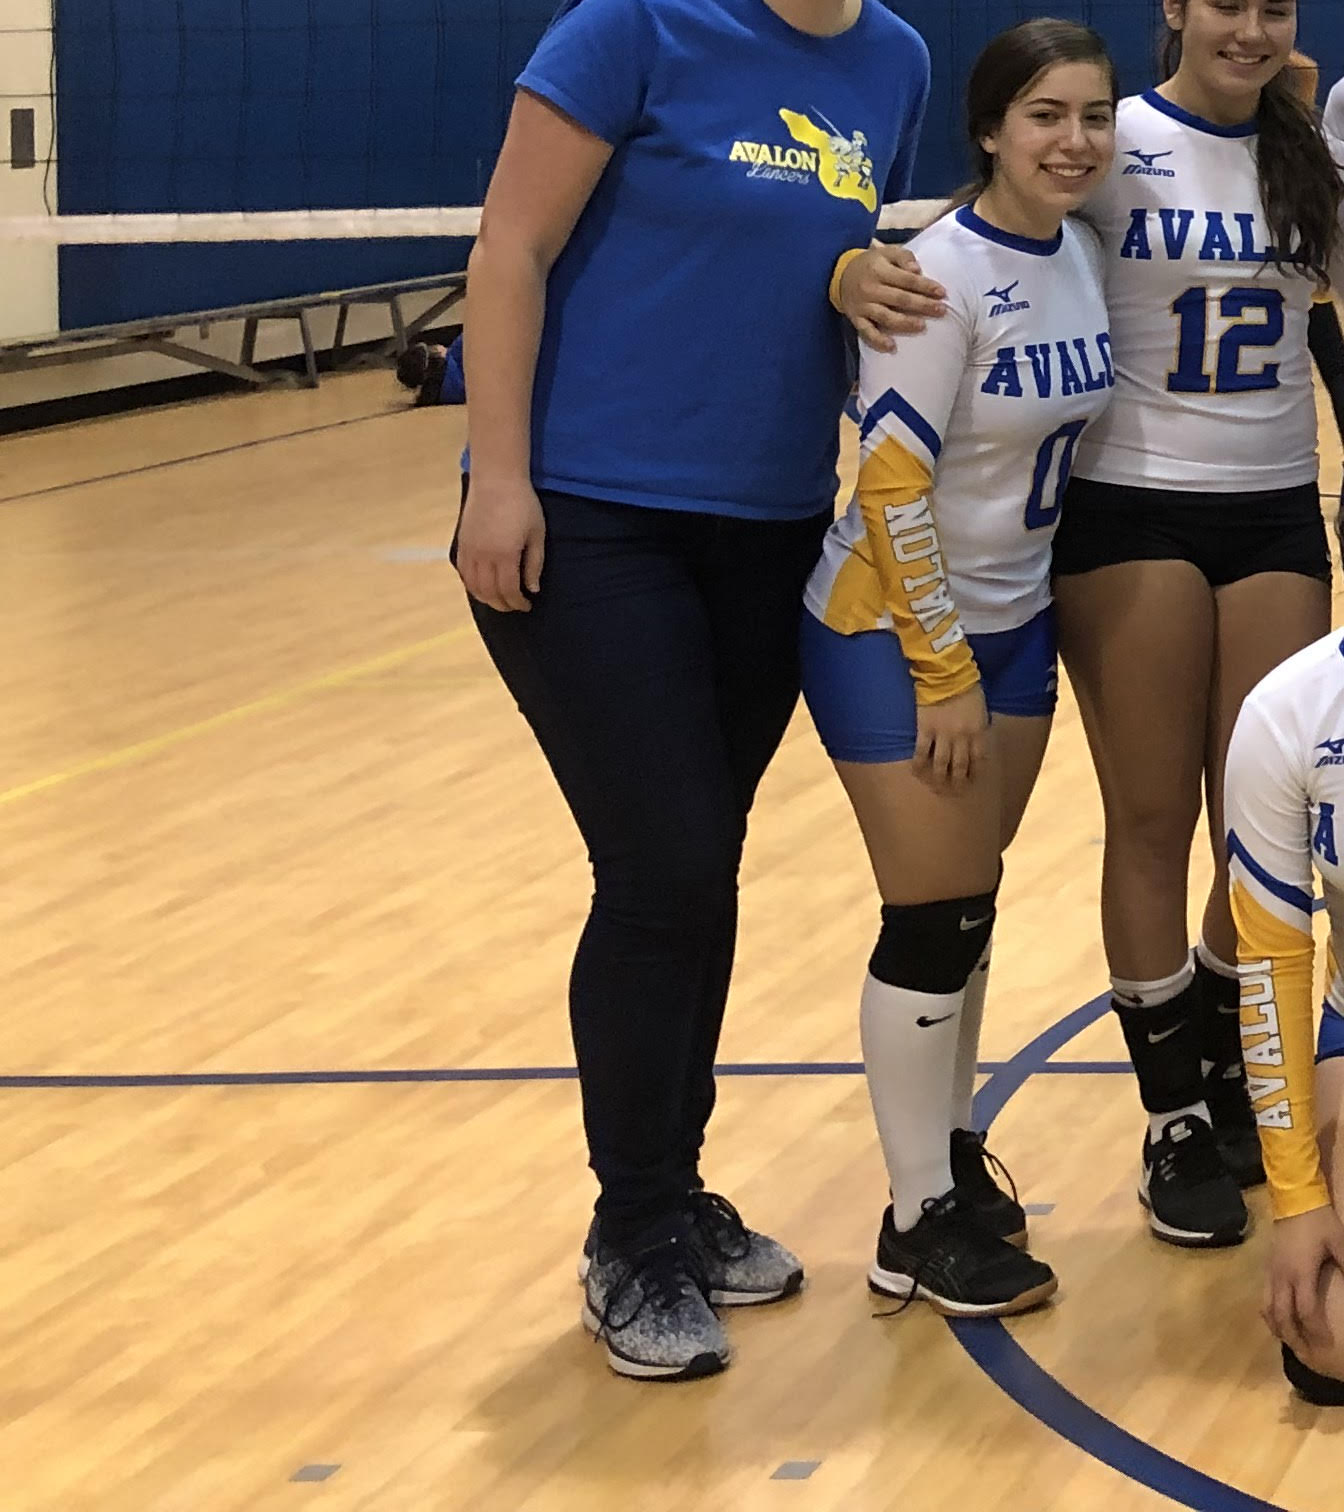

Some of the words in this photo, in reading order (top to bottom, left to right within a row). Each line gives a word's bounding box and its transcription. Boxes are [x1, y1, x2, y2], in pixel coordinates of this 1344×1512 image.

[729, 141, 817, 172] AVALON
[1167, 287, 1285, 393] 12
[1025, 419, 1088, 530] 0
